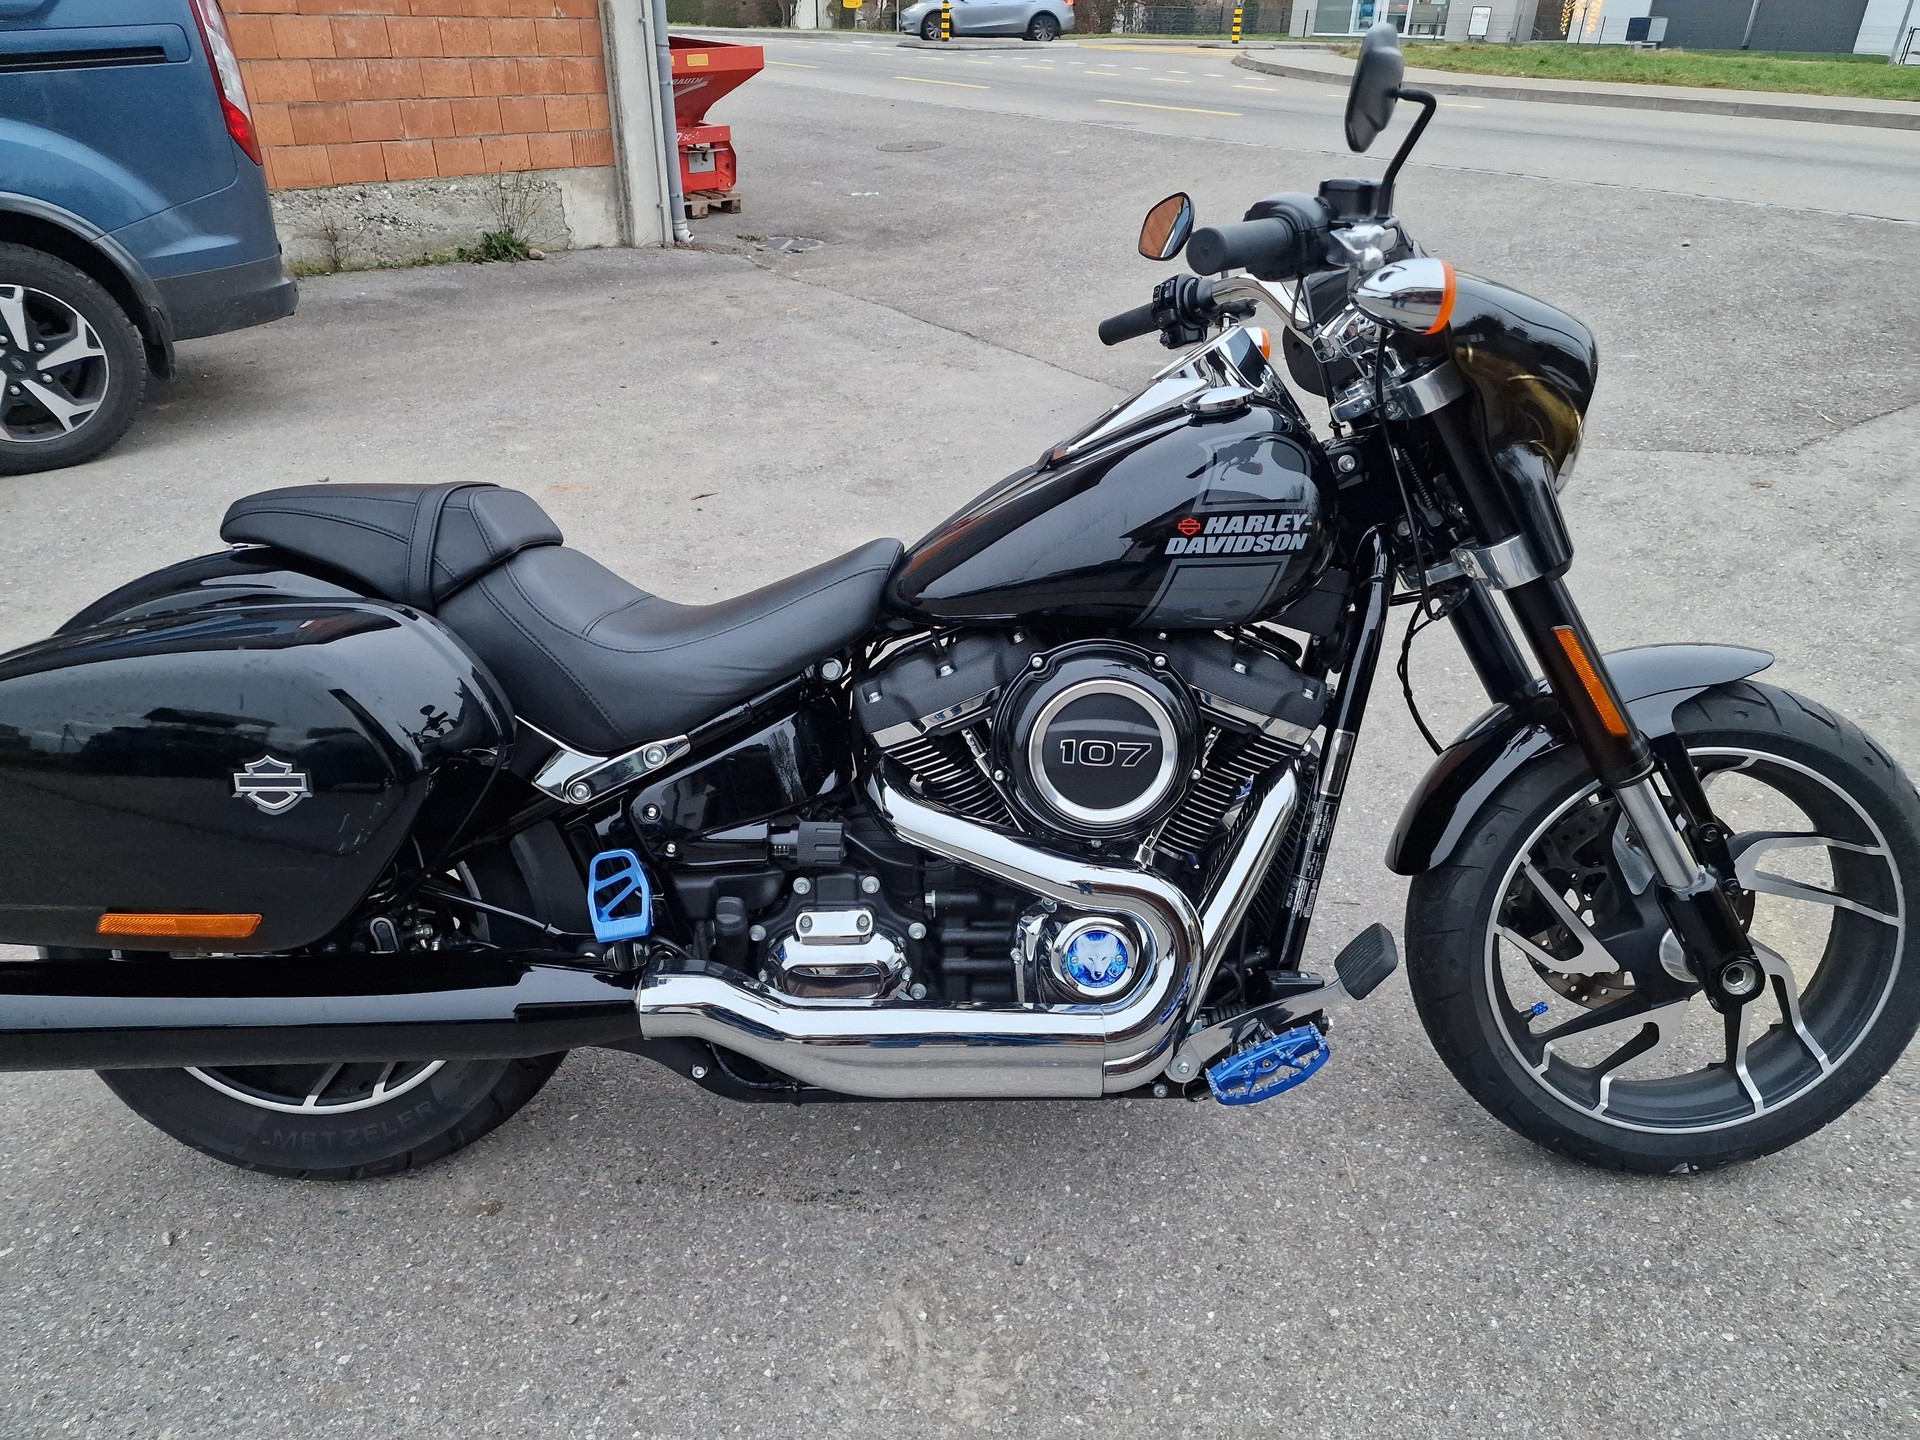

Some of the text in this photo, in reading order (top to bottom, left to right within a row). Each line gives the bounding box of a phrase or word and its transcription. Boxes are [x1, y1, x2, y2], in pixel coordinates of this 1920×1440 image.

[1203, 513, 1312, 535] HARLEY-
[1164, 533, 1308, 555] DAVIDSON
[1060, 739, 1152, 767] 107
[272, 1101, 433, 1150] METZELER
